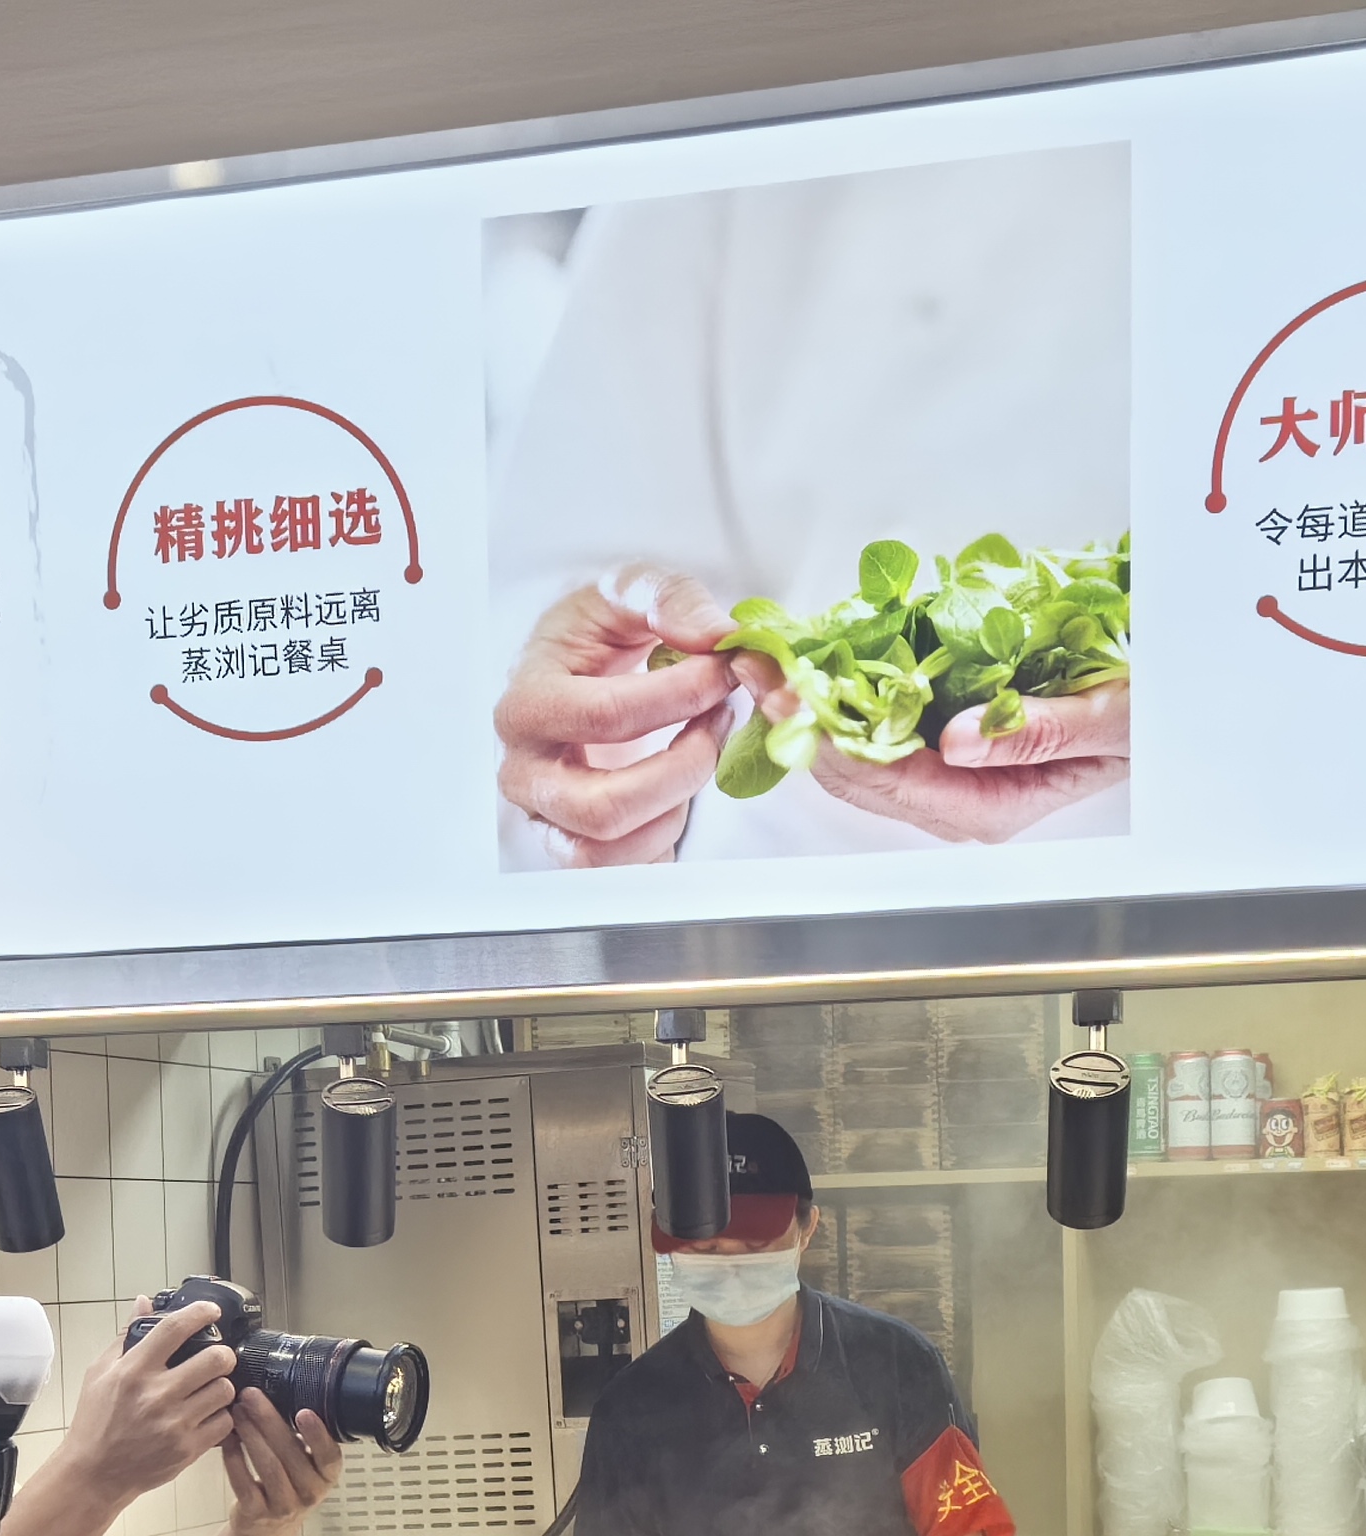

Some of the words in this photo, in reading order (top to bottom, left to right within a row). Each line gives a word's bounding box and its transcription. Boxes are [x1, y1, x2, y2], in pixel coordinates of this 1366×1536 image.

[152, 487, 384, 564] 精挑细选
[144, 586, 382, 643] 让劣质原料远离
[181, 636, 351, 686] 蒸浏记餐桌
[1147, 1076, 1159, 1140] TSINGTAO
[938, 1460, 998, 1523] 安全
